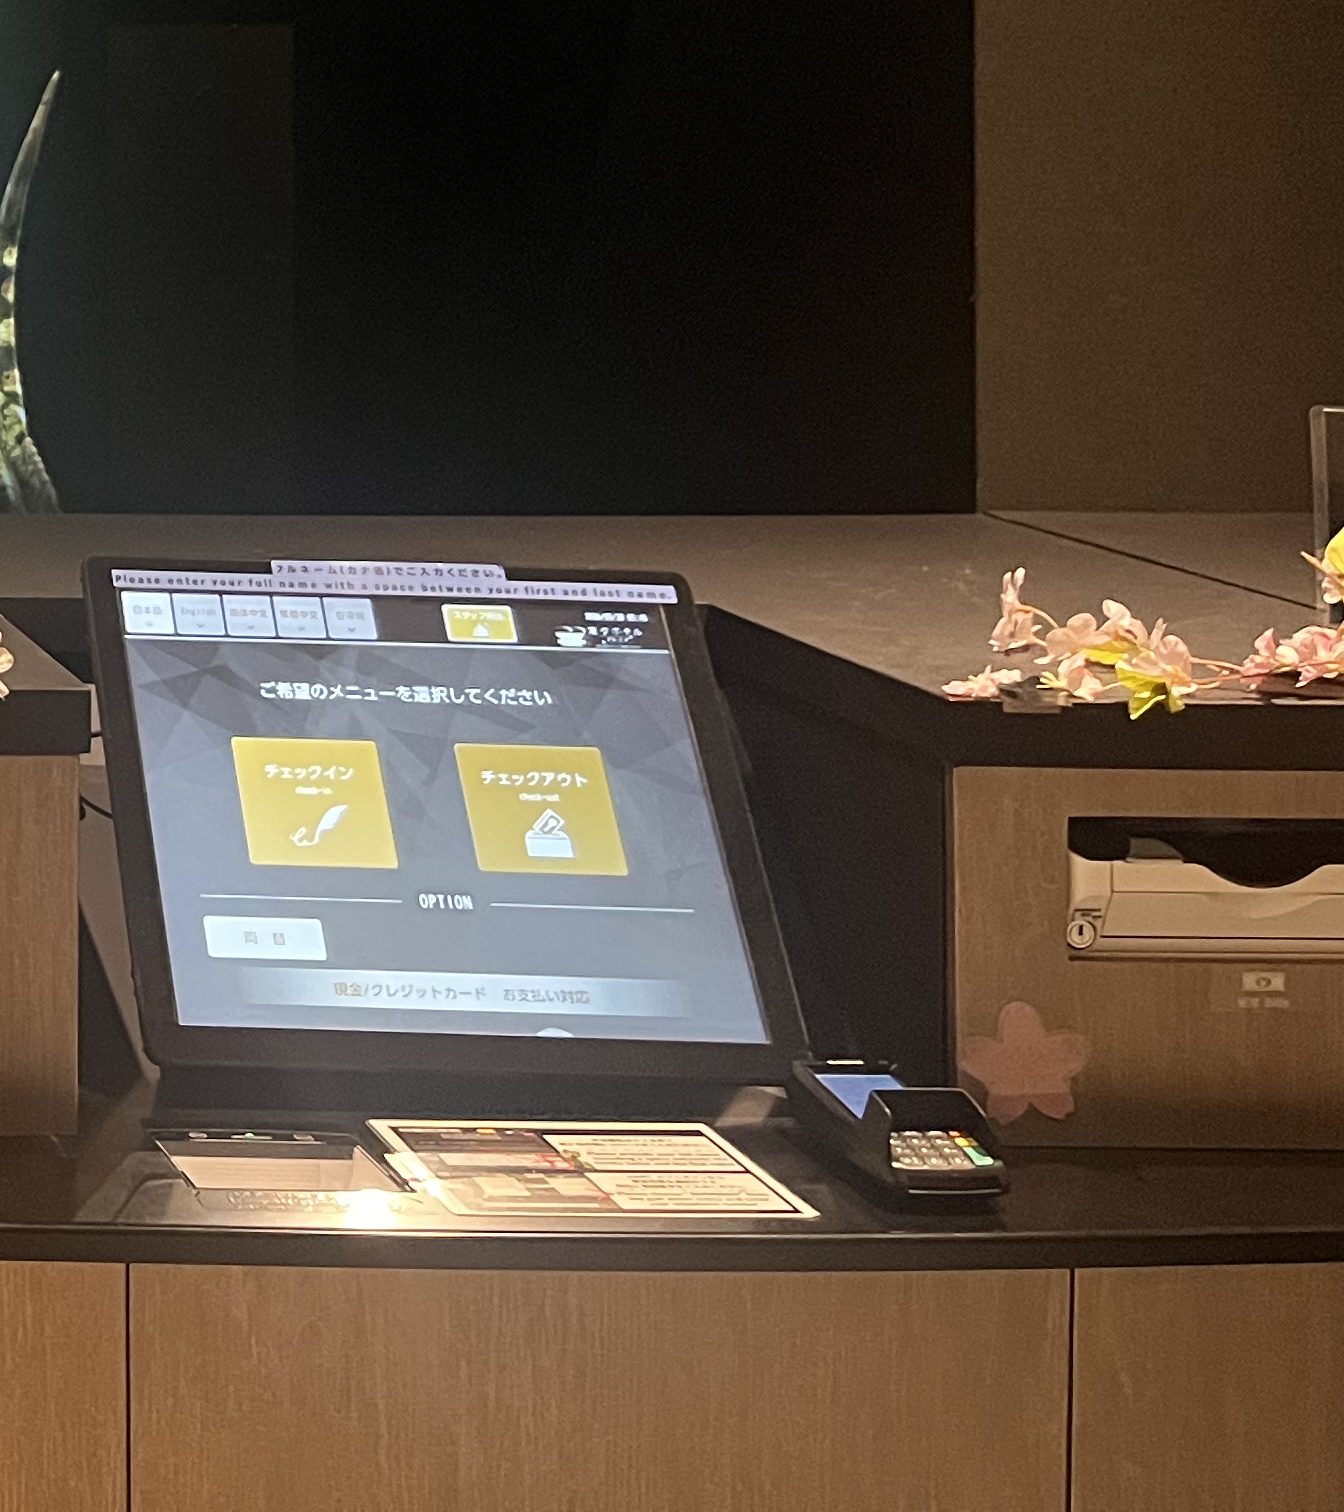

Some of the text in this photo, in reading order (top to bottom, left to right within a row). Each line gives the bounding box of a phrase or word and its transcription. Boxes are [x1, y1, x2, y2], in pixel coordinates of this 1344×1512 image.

[115, 574, 161, 585] Please
[168, 576, 205, 586] enter
[211, 577, 243, 588] your
[249, 577, 273, 588] full
[279, 579, 317, 589] name
[324, 579, 355, 590] with
[374, 582, 415, 593] space
[420, 582, 482, 594] between
[488, 585, 519, 596] your
[524, 585, 555, 596] first
[562, 586, 587, 597] and
[593, 587, 621, 598] last
[180, 605, 217, 617] English
[259, 681, 553, 706] ご希望のメニューを選択してください
[264, 763, 354, 781] チェックイン
[480, 769, 589, 788] チェックアウト
[418, 893, 474, 911] OPTION
